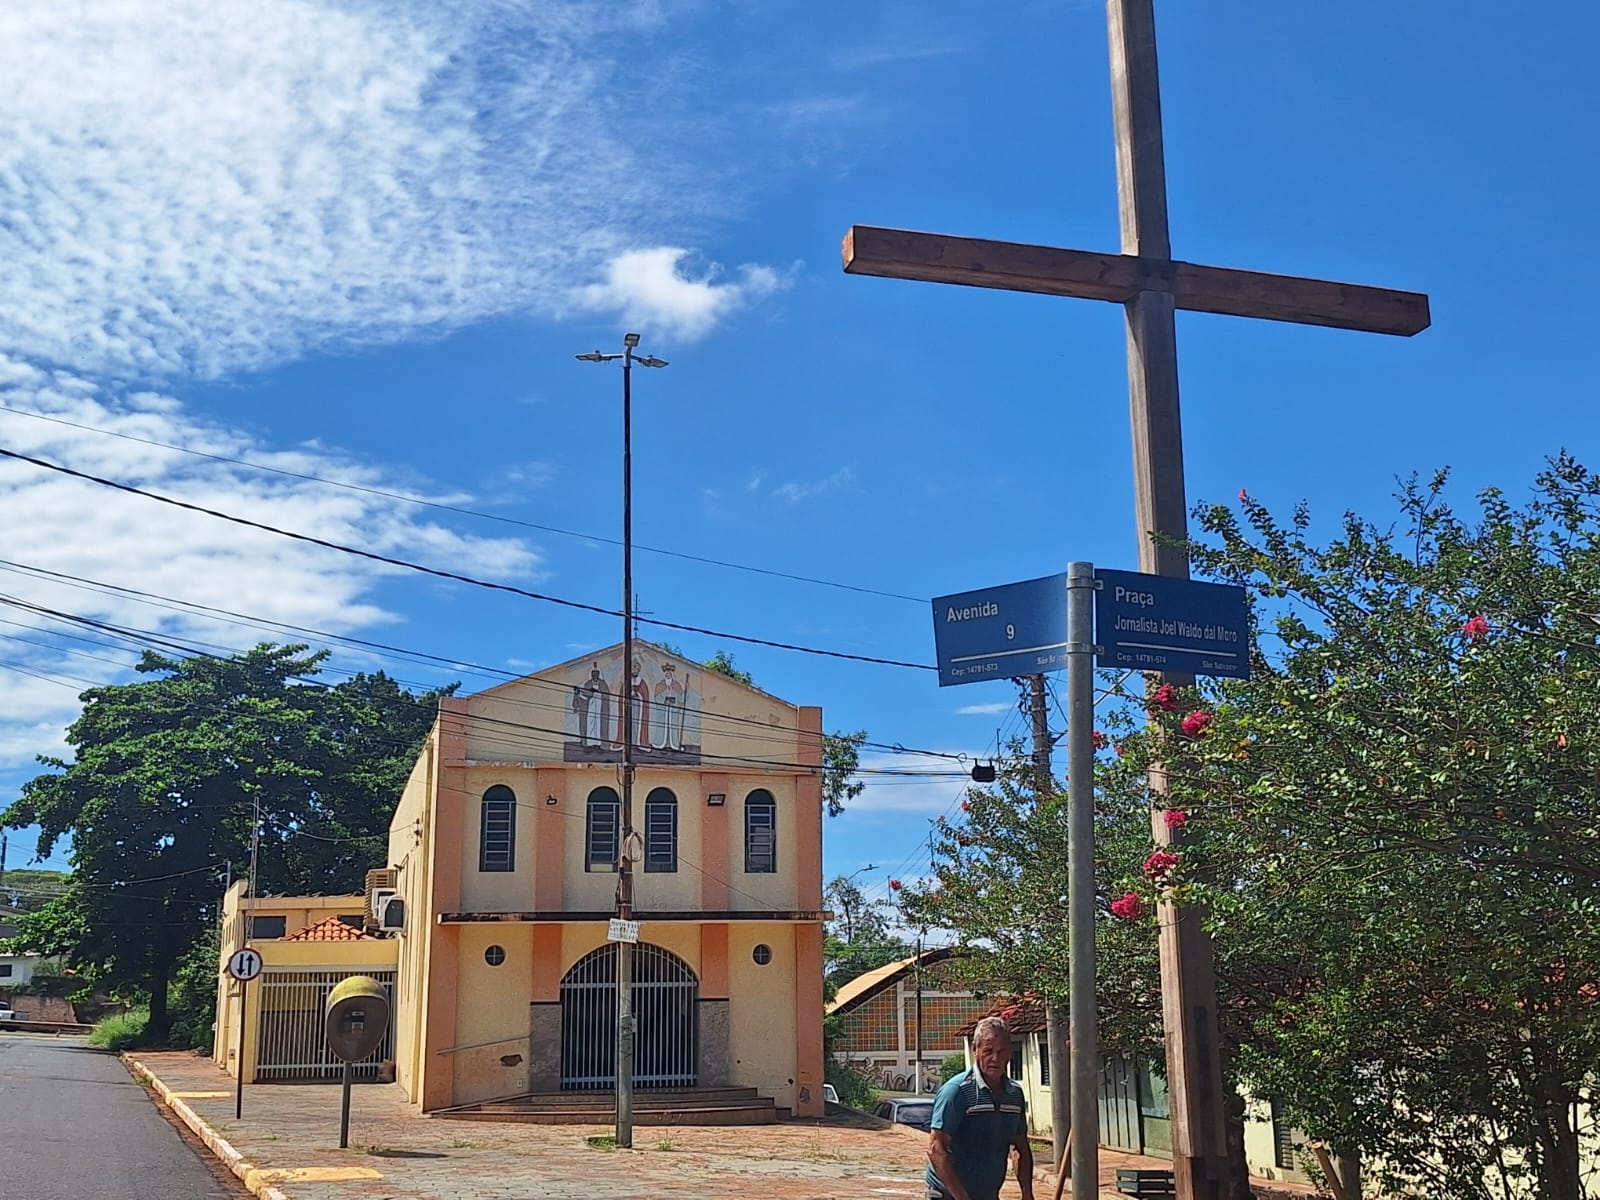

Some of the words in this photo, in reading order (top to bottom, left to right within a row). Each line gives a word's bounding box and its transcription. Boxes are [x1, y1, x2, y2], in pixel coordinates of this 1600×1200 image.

[1115, 586, 1154, 608] Praça
[947, 601, 999, 622] Avenida
[1006, 624, 1015, 640] 9
[1114, 614, 1158, 634] Jornalista
[1160, 619, 1177, 636] Joel
[1177, 621, 1203, 639] Waldo
[1203, 624, 1216, 640] dal
[1217, 625, 1238, 642] Moro
